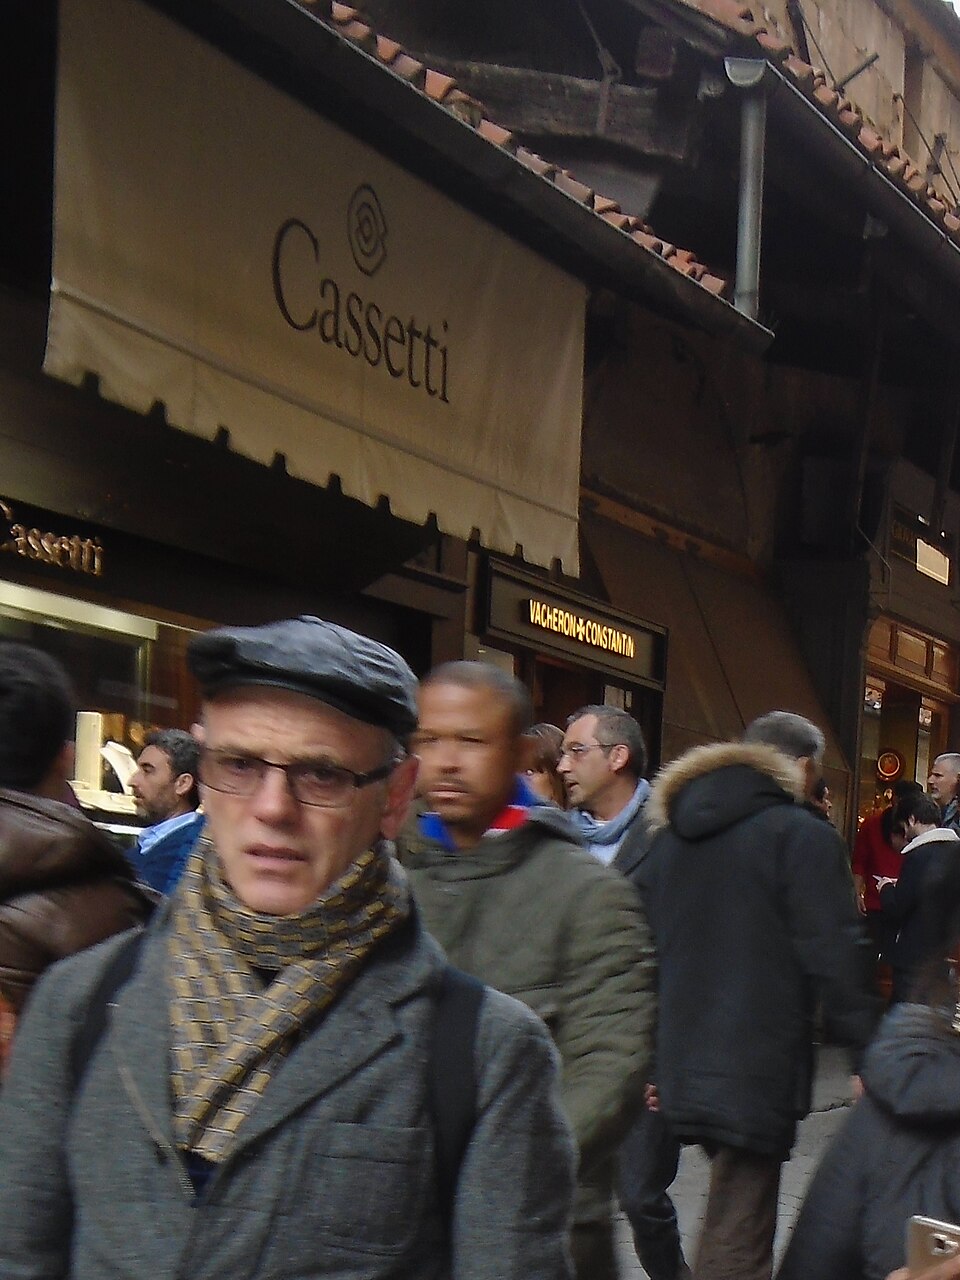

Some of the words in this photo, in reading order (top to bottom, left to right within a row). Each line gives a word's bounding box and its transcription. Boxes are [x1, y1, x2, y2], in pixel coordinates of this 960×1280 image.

[272, 217, 449, 403] Cassetti
[529, 599, 577, 638] VACHERON
[585, 619, 635, 659] CONSTANTIN
